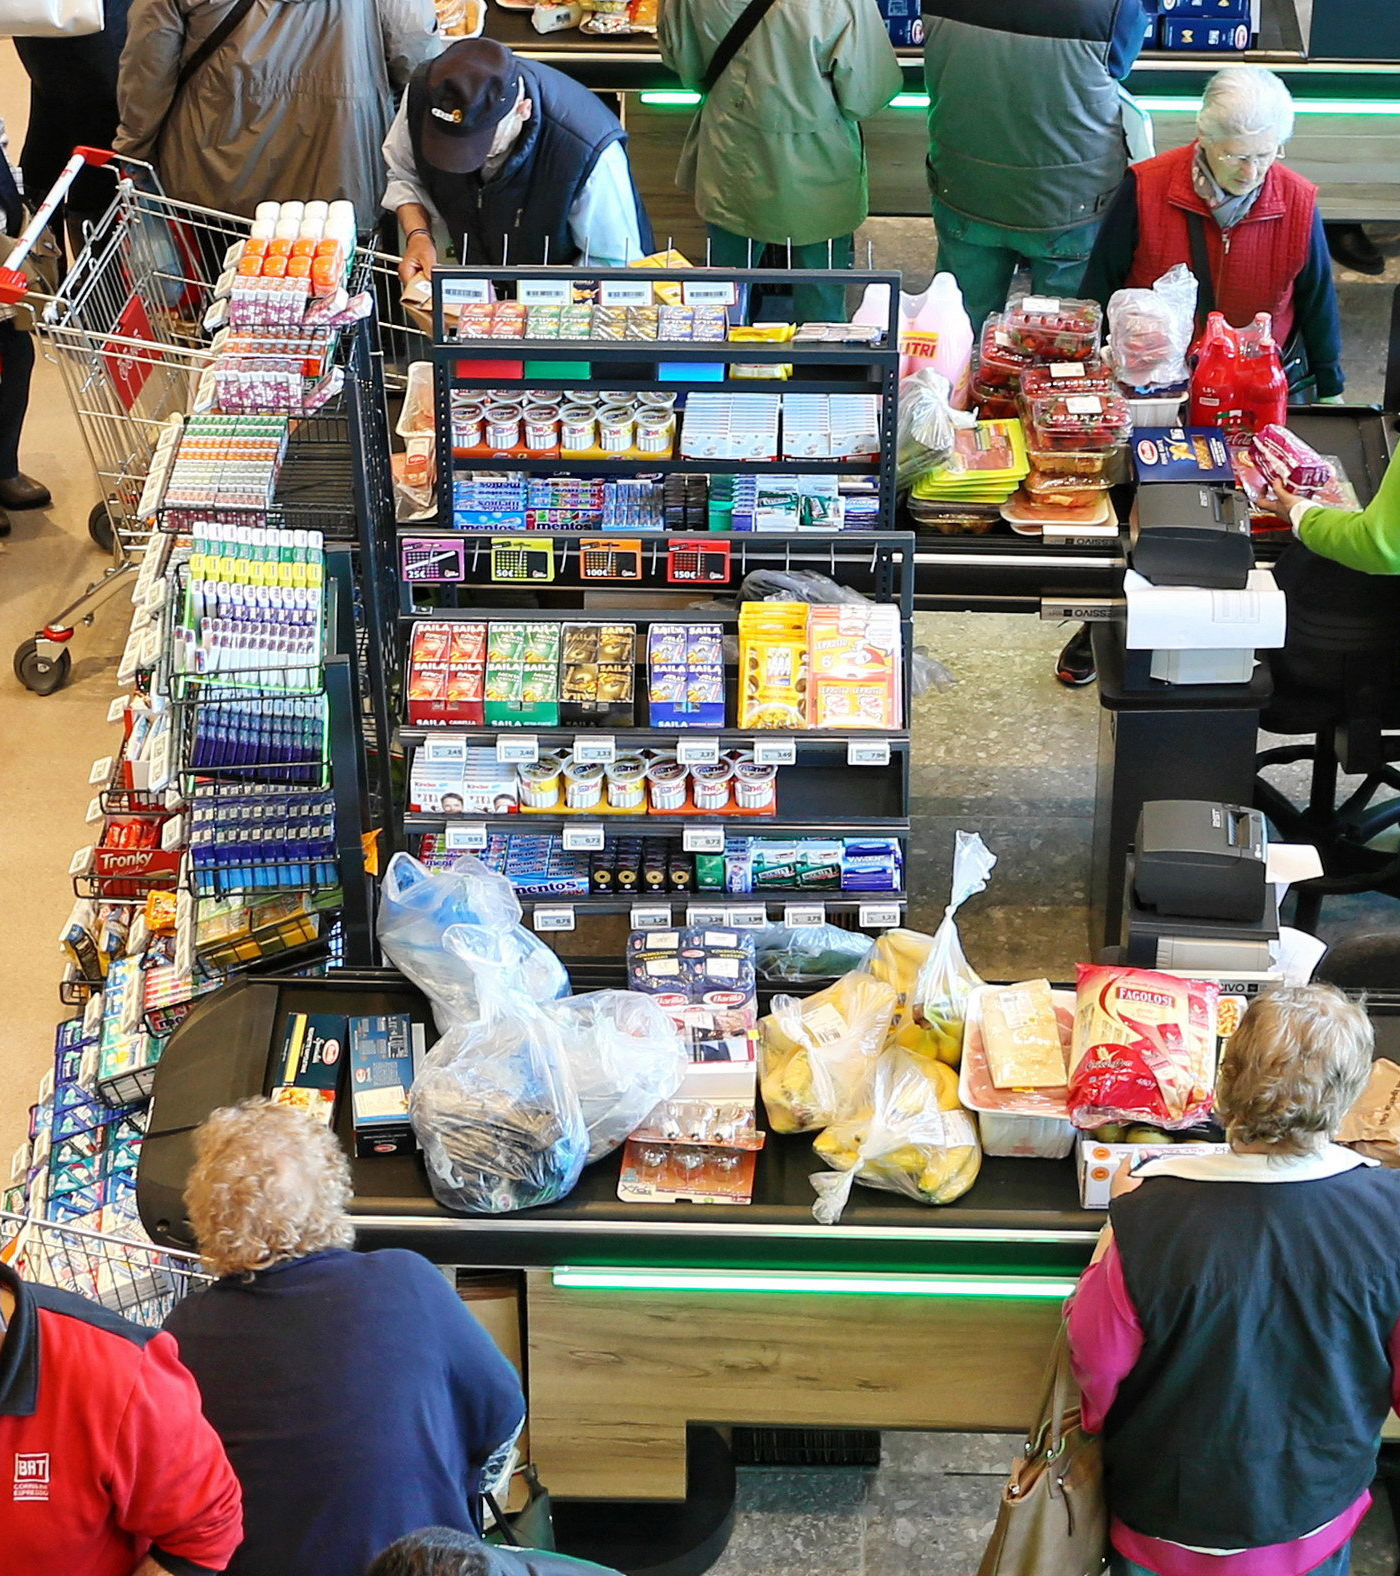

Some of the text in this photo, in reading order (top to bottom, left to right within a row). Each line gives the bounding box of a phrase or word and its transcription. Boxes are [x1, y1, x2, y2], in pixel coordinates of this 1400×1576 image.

[407, 570, 425, 579] 25€
[496, 569, 514, 578] 50€
[586, 568, 608, 577] 100€
[674, 571, 697, 580] 150€
[417, 624, 449, 633] SAILA
[452, 625, 485, 633] SAILA
[491, 625, 523, 633] SAILA
[689, 627, 721, 635] SAILA
[414, 663, 448, 671] SAILA
[450, 663, 483, 671] SAILA
[488, 663, 521, 672] SAILA
[524, 664, 557, 672] SAILA
[653, 665, 686, 673] SAILA
[689, 665, 721, 673] SAILA
[99, 851, 153, 868] Tronky
[712, 994, 744, 1004] Barilla
[1118, 987, 1174, 1007] FAGOLOSI
[18, 1460, 46, 1476] BRT
